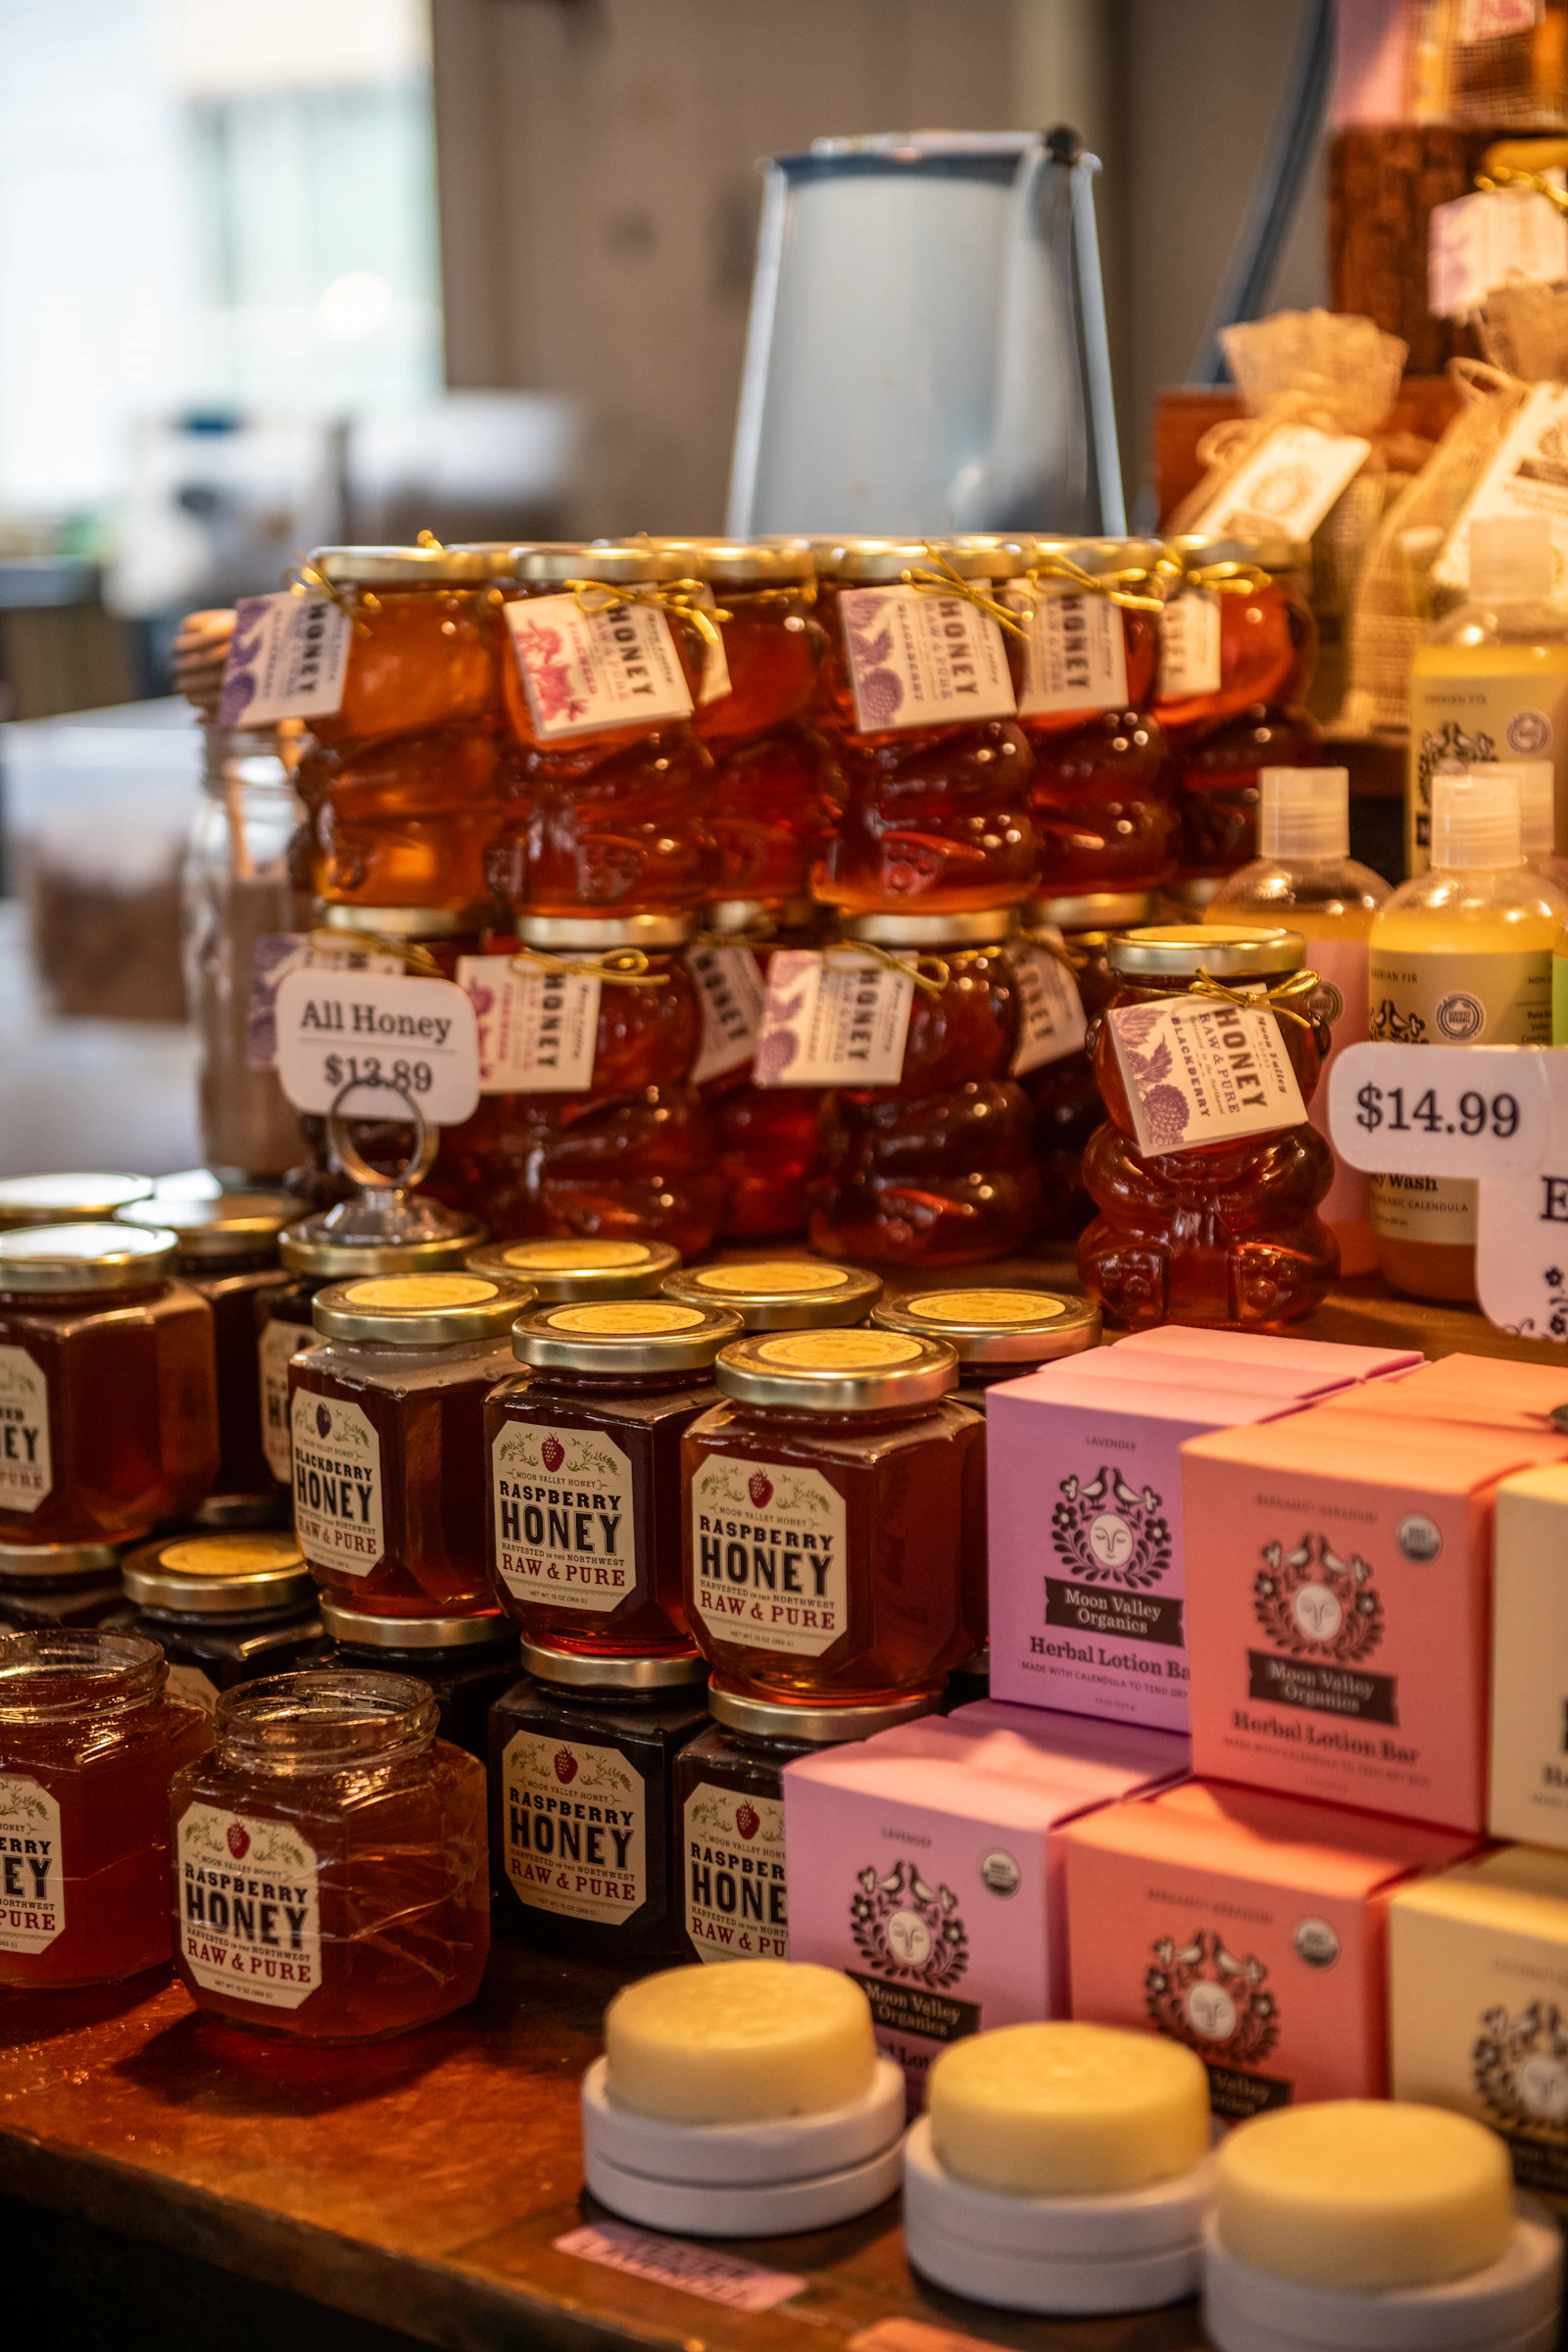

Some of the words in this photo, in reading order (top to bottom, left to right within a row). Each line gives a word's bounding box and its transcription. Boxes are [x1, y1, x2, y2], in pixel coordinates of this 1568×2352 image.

[298, 600, 327, 693] HONEY
[607, 603, 657, 696] HONEY
[938, 600, 979, 696] HONEY
[1059, 595, 1091, 687] HONEY
[301, 1001, 345, 1030] All
[352, 1004, 454, 1045] Honey
[538, 972, 566, 1070] HONEY
[849, 968, 879, 1061] HONEY
[1199, 1011, 1221, 1052] RAW
[1170, 1016, 1211, 1118] BLACKBERRY
[1212, 1006, 1269, 1108] HONEY
[1213, 1053, 1225, 1065] &
[1255, 1014, 1272, 1052] Moon
[1271, 1052, 1288, 1095] Valley
[1217, 1068, 1241, 1114] PURE
[1356, 1081, 1521, 1139] $14.99
[1389, 1173, 1439, 1193] Wash
[1408, 1198, 1469, 1213] CALENDULA
[1086, 1435, 1138, 1452] LAVENDER
[295, 1446, 372, 1483] BLACKBERRY
[516, 1470, 537, 1482] MOON
[539, 1475, 566, 1486] VALLEY
[567, 1478, 596, 1489] HONEY
[296, 1462, 373, 1526] HONEY
[500, 1480, 621, 1511] RASPBERRY
[298, 1515, 321, 1541] RAW
[322, 1528, 332, 1545] &
[334, 1530, 377, 1556] PURE
[335, 1520, 376, 1536] NORTHWEST
[501, 1498, 622, 1556] HONEY
[700, 1514, 834, 1551] RASPBERRY
[719, 1506, 743, 1518] MOON
[745, 1510, 774, 1523] VALLEY
[776, 1516, 808, 1528] HONEY
[502, 1542, 545, 1558] HARVESTED
[567, 1553, 625, 1567] NORTHWEST
[502, 1553, 543, 1577] RAW
[547, 1562, 561, 1581] &
[565, 1564, 625, 1588] PURE
[700, 1534, 835, 1598] HONEY
[700, 1579, 749, 1596] HARVESTED
[773, 1593, 836, 1610] NORTHWEST
[700, 1590, 746, 1617] RAW
[751, 1602, 764, 1622] &
[771, 1604, 836, 1631] PURE
[1064, 1587, 1110, 1613] Moon
[1111, 1594, 1162, 1624] Valley
[1077, 1606, 1150, 1636] Organics
[1030, 1635, 1096, 1664] Herbal
[1098, 1647, 1164, 1678] Lotion
[1021, 1660, 1048, 1675] MADE
[1049, 1665, 1074, 1680] WITH
[1074, 1671, 1128, 1690] CALENDULA
[1129, 1681, 1143, 1691] TO
[1145, 1683, 1169, 1696] TEND
[1170, 1689, 1190, 1700] DRY
[1268, 1660, 1317, 1687] Moon
[1321, 1670, 1374, 1701] Valley
[1283, 1683, 1361, 1714] Organics
[1232, 1710, 1302, 1741] Herbal
[1306, 1725, 1377, 1756] Lotion
[1380, 1739, 1419, 1764] Bar
[510, 1786, 634, 1827] RASPBERRY
[527, 1780, 549, 1791] MOON
[551, 1785, 578, 1798] VALLEY
[580, 1791, 609, 1803] HONEY
[0, 1837, 52, 1856] ERRY
[510, 1804, 634, 1871] HONEY
[709, 1835, 731, 1847] MOON
[733, 1841, 760, 1856] VALLEY
[3, 1854, 53, 1900] EY
[185, 1861, 309, 1904] RASPBERRY
[511, 1847, 555, 1867] HARVESTED
[577, 1866, 636, 1882] NORTHWEST
[511, 1857, 554, 1885] RAW
[557, 1872, 570, 1890] &
[575, 1875, 636, 1902] PURE
[691, 1861, 788, 1927] HONE
[185, 1880, 310, 1952] HONEY
[691, 1905, 736, 1927] HARVESTED
[691, 1915, 735, 1945] RAW
[739, 1933, 753, 1952] &
[759, 1936, 787, 1958] PU
[187, 1936, 227, 1967] RAW
[231, 1952, 245, 1974] &
[250, 1956, 312, 1984] PURE
[865, 1982, 907, 2009] Moon
[909, 1992, 961, 2025] Valley
[878, 2005, 949, 2037] Organics
